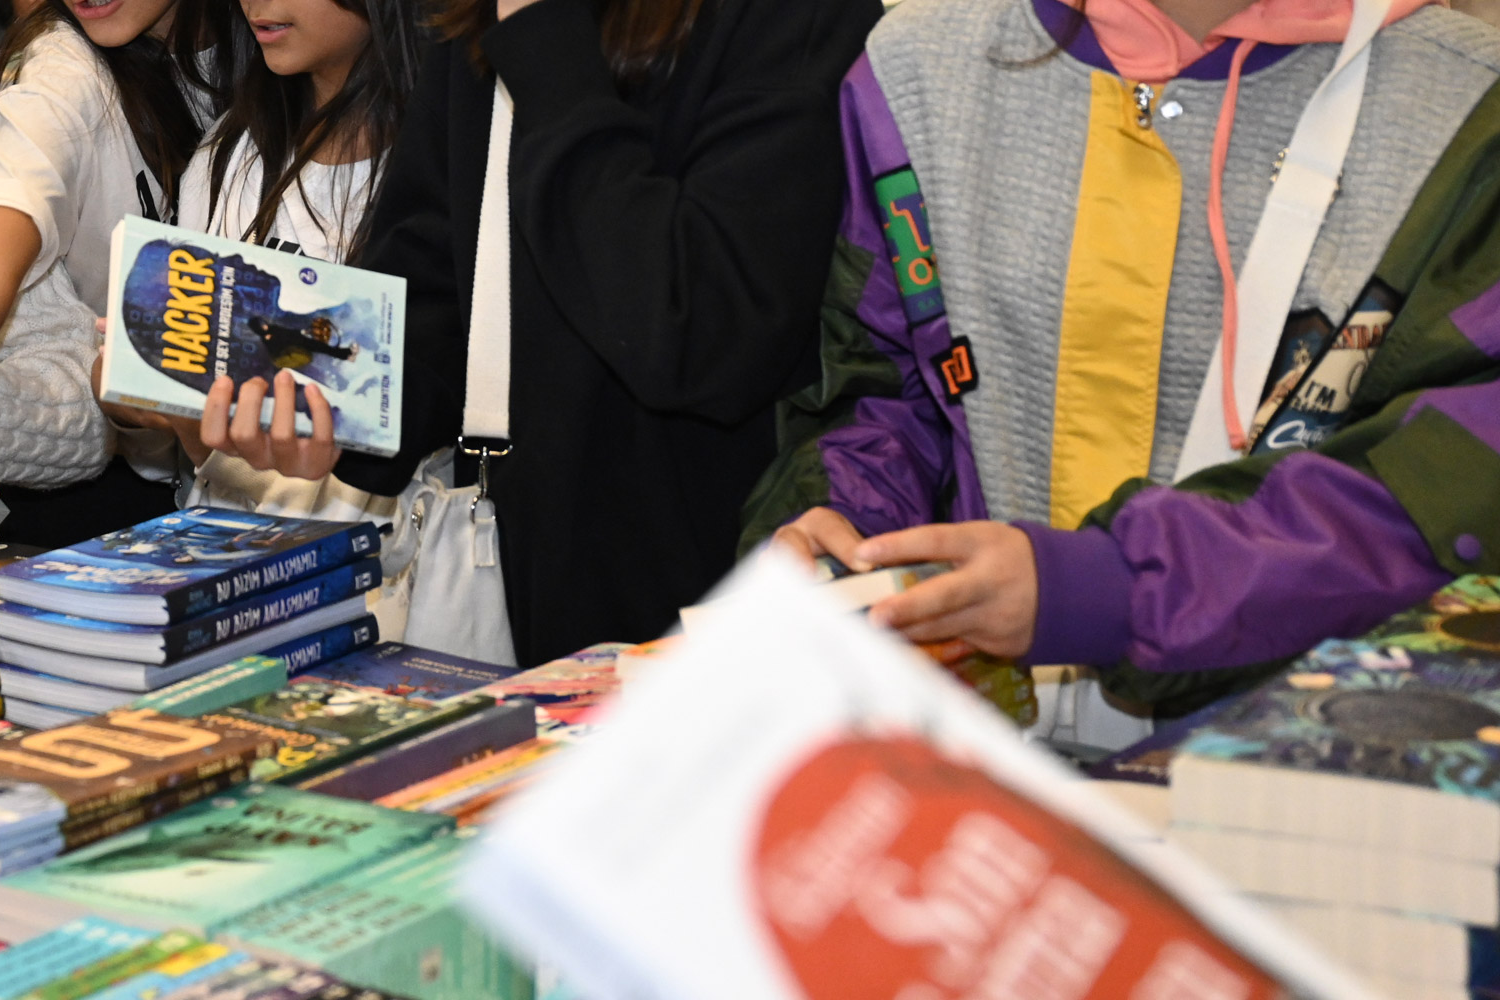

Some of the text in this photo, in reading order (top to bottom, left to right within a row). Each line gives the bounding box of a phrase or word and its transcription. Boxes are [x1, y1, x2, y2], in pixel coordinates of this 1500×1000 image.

[160, 248, 216, 375] HACKER
[215, 581, 231, 603] BU
[232, 570, 261, 597] BİZİM
[263, 550, 318, 587] ANLAŞMAMIZ
[215, 587, 320, 641] BU BİZİM ANLAŞMAMIZ
[280, 642, 322, 672] AŞMAMIZ
